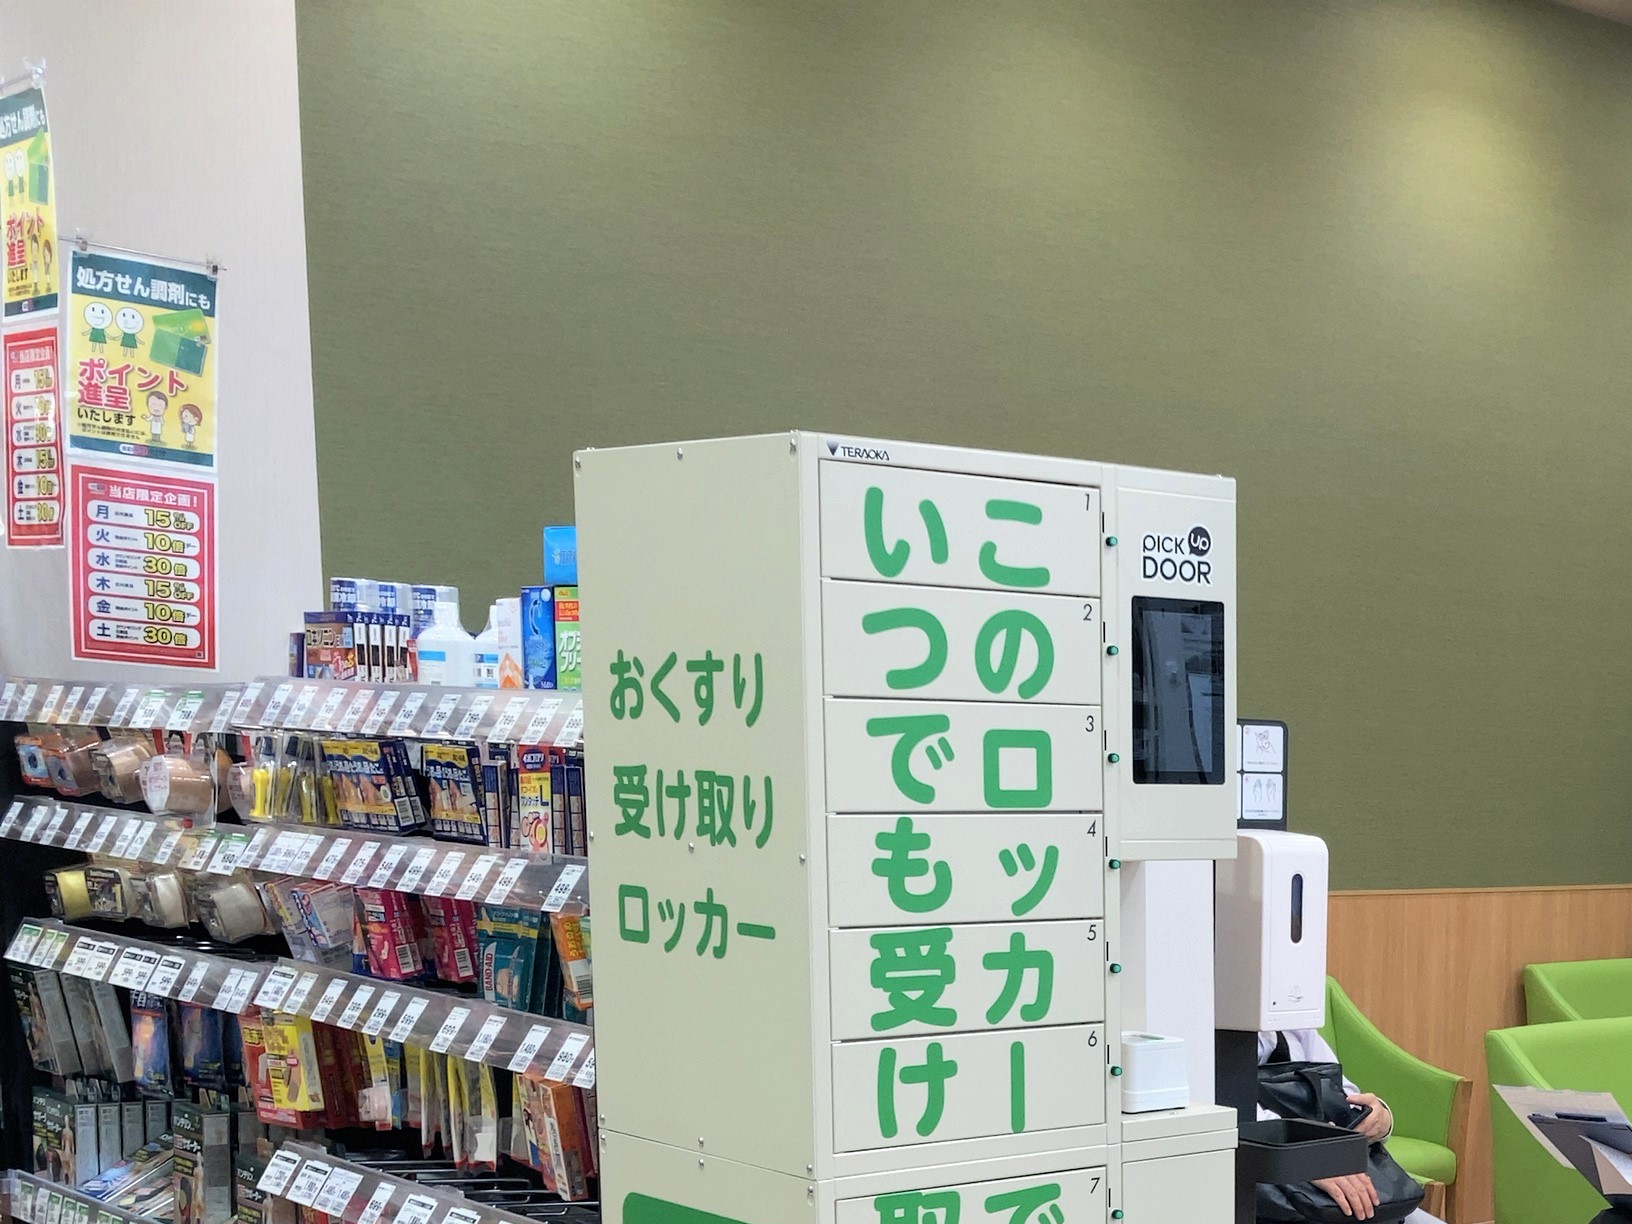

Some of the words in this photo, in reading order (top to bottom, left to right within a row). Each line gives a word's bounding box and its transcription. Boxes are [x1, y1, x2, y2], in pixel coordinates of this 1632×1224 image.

[77, 266, 211, 310] 処方せん調剤にも
[79, 358, 187, 396] ポイント
[78, 381, 131, 410] 進呈
[77, 408, 136, 427] いたします
[841, 445, 890, 461] TERAOKA
[1084, 494, 1091, 511] 1
[95, 504, 109, 519] 月
[144, 509, 171, 528] 15
[173, 521, 194, 531] OFF
[95, 529, 110, 543] 火
[96, 552, 110, 566] 水
[1142, 558, 1212, 585] DOOR
[96, 577, 110, 591] 木
[144, 579, 172, 597] 15
[173, 591, 195, 600] OFF
[96, 599, 111, 614] 金
[1083, 604, 1093, 621] 2
[97, 623, 111, 637] 土
[610, 649, 764, 727] おくすり
[1085, 716, 1096, 733] 3
[612, 764, 774, 849] 受け取り
[1087, 821, 1098, 838] 4
[618, 884, 776, 960] ロッカー
[1087, 925, 1098, 942] 5
[1088, 1031, 1098, 1048] 6
[1089, 1177, 1100, 1194] 7
